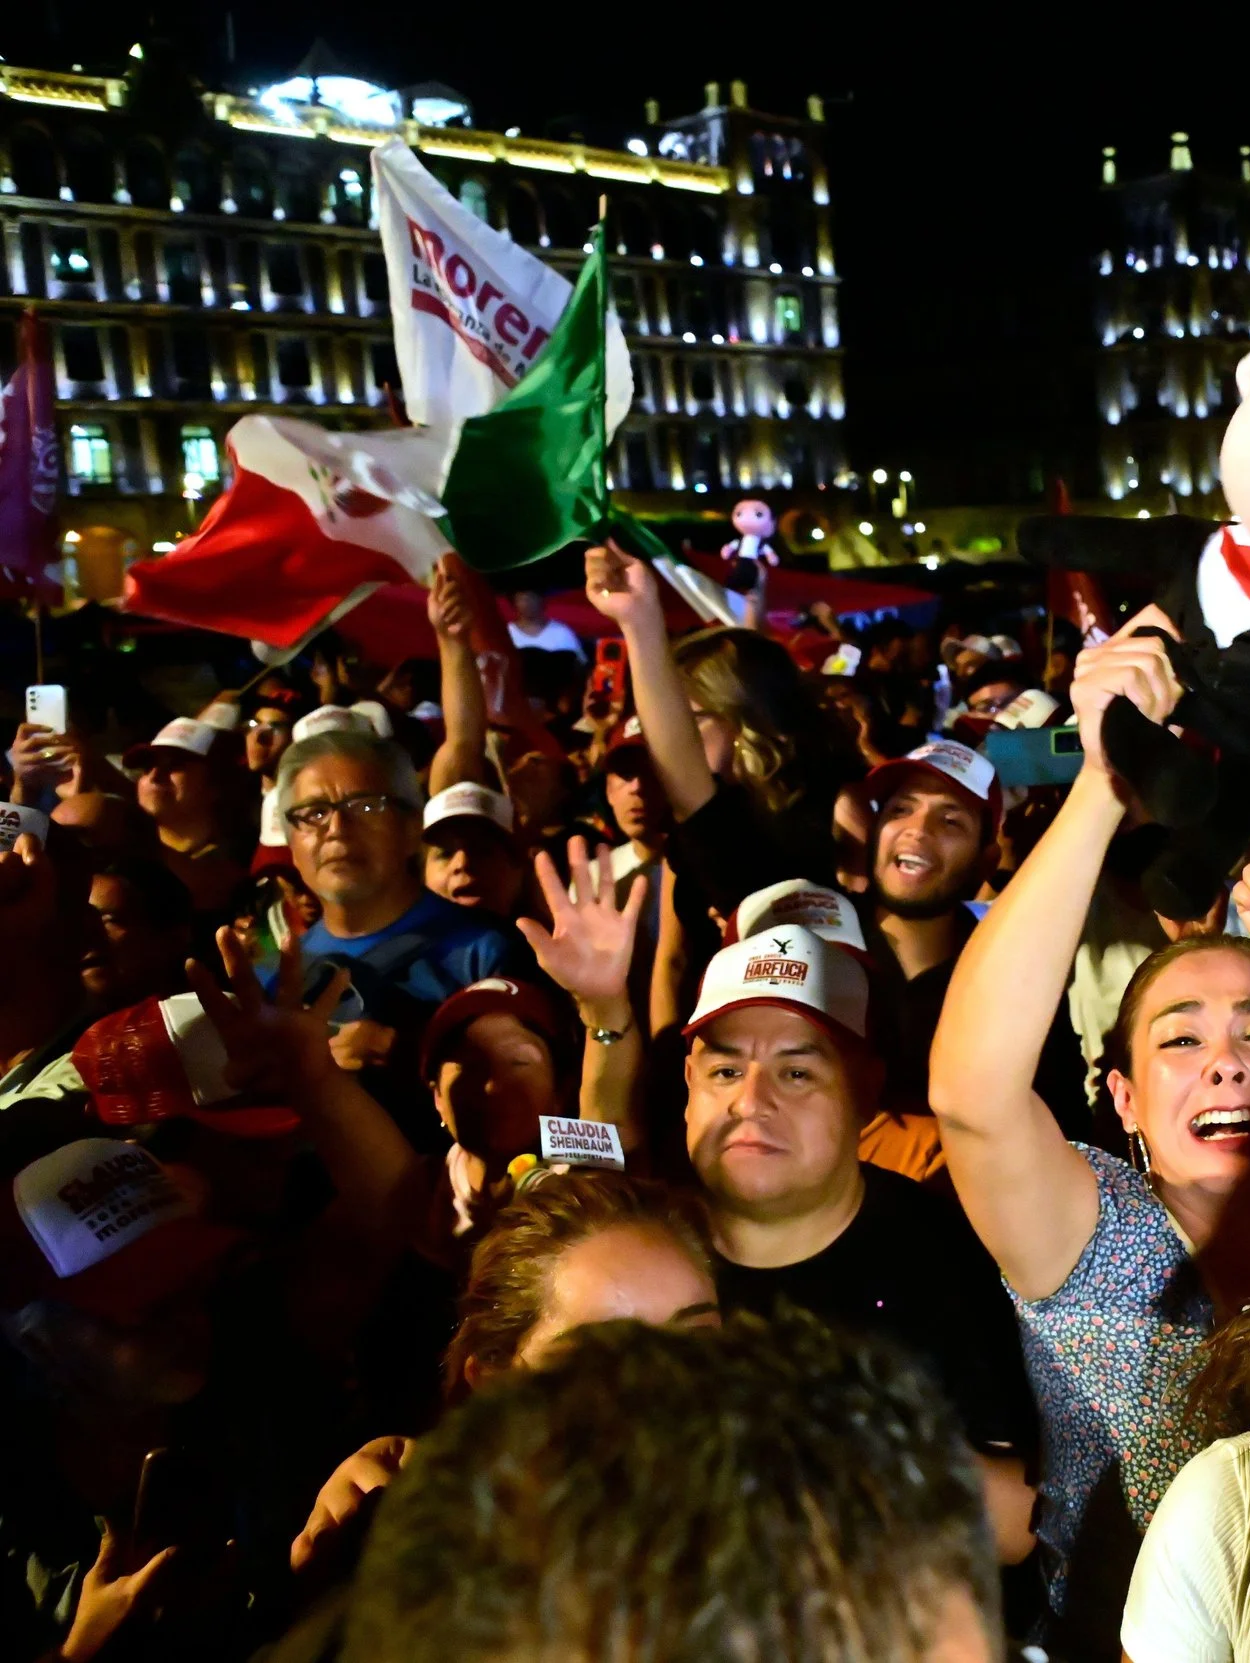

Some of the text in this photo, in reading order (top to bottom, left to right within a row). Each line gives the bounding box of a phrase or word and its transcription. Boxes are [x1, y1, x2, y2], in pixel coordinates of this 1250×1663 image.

[746, 961, 808, 980] HARFUCH
[548, 1120, 611, 1140] CLAUDIA
[550, 1136, 614, 1153] SHEINBAUM
